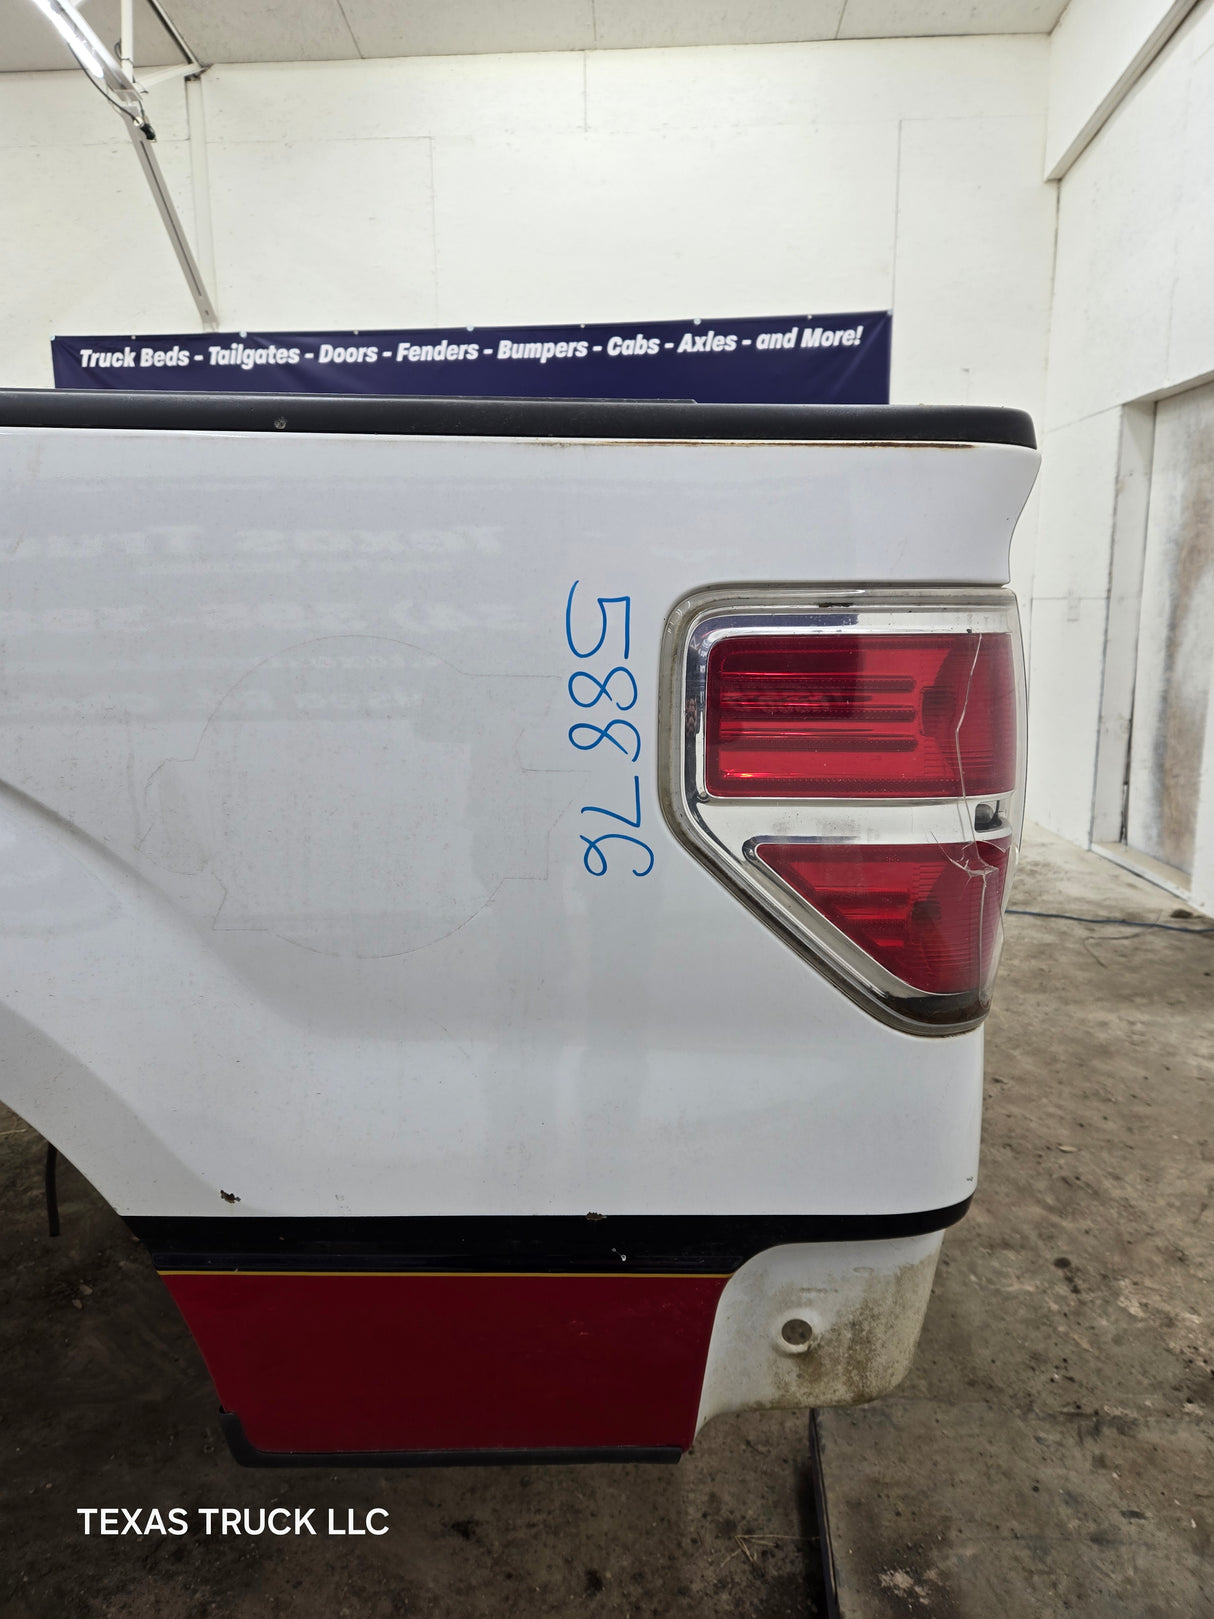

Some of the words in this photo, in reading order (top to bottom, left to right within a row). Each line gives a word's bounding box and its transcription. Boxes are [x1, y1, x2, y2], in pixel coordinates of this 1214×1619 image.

[80, 346, 136, 368] Truck
[139, 345, 190, 367] Beds
[208, 342, 301, 371] Tailgates
[317, 343, 379, 364] Doors
[395, 340, 480, 362] Fenders
[496, 339, 589, 364] Bumpers
[606, 334, 661, 356] Cabs
[676, 331, 738, 353] Axles
[755, 327, 799, 350] and
[800, 325, 864, 347] More!
[565, 580, 655, 877] 58876
